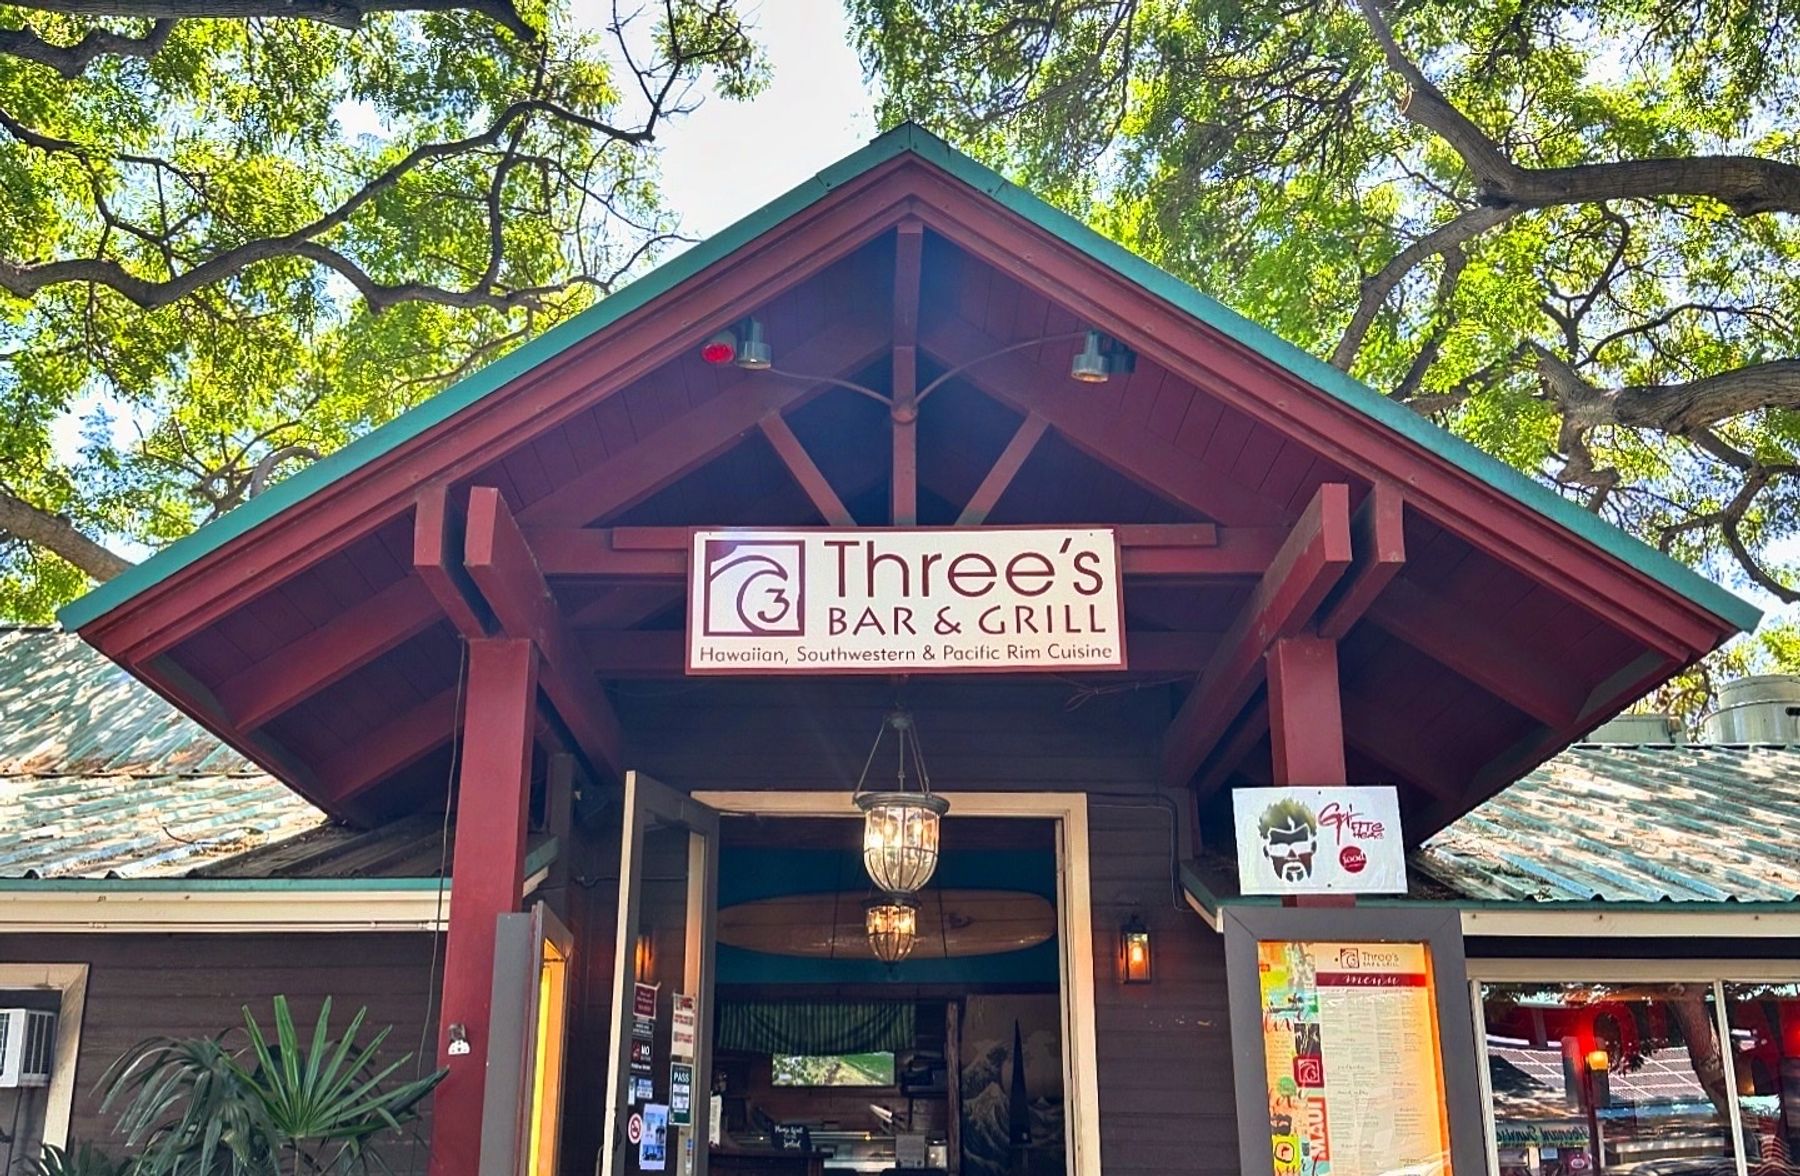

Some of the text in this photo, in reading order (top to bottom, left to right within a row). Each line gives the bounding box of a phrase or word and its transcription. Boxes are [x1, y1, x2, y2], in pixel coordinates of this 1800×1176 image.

[824, 537, 1104, 599] Three's
[829, 604, 1107, 636] BAR & GRILL
[699, 642, 1114, 665] Hawaiian, Southwestern & Pacific Rim Cuisine
[673, 1072, 690, 1084] PASS
